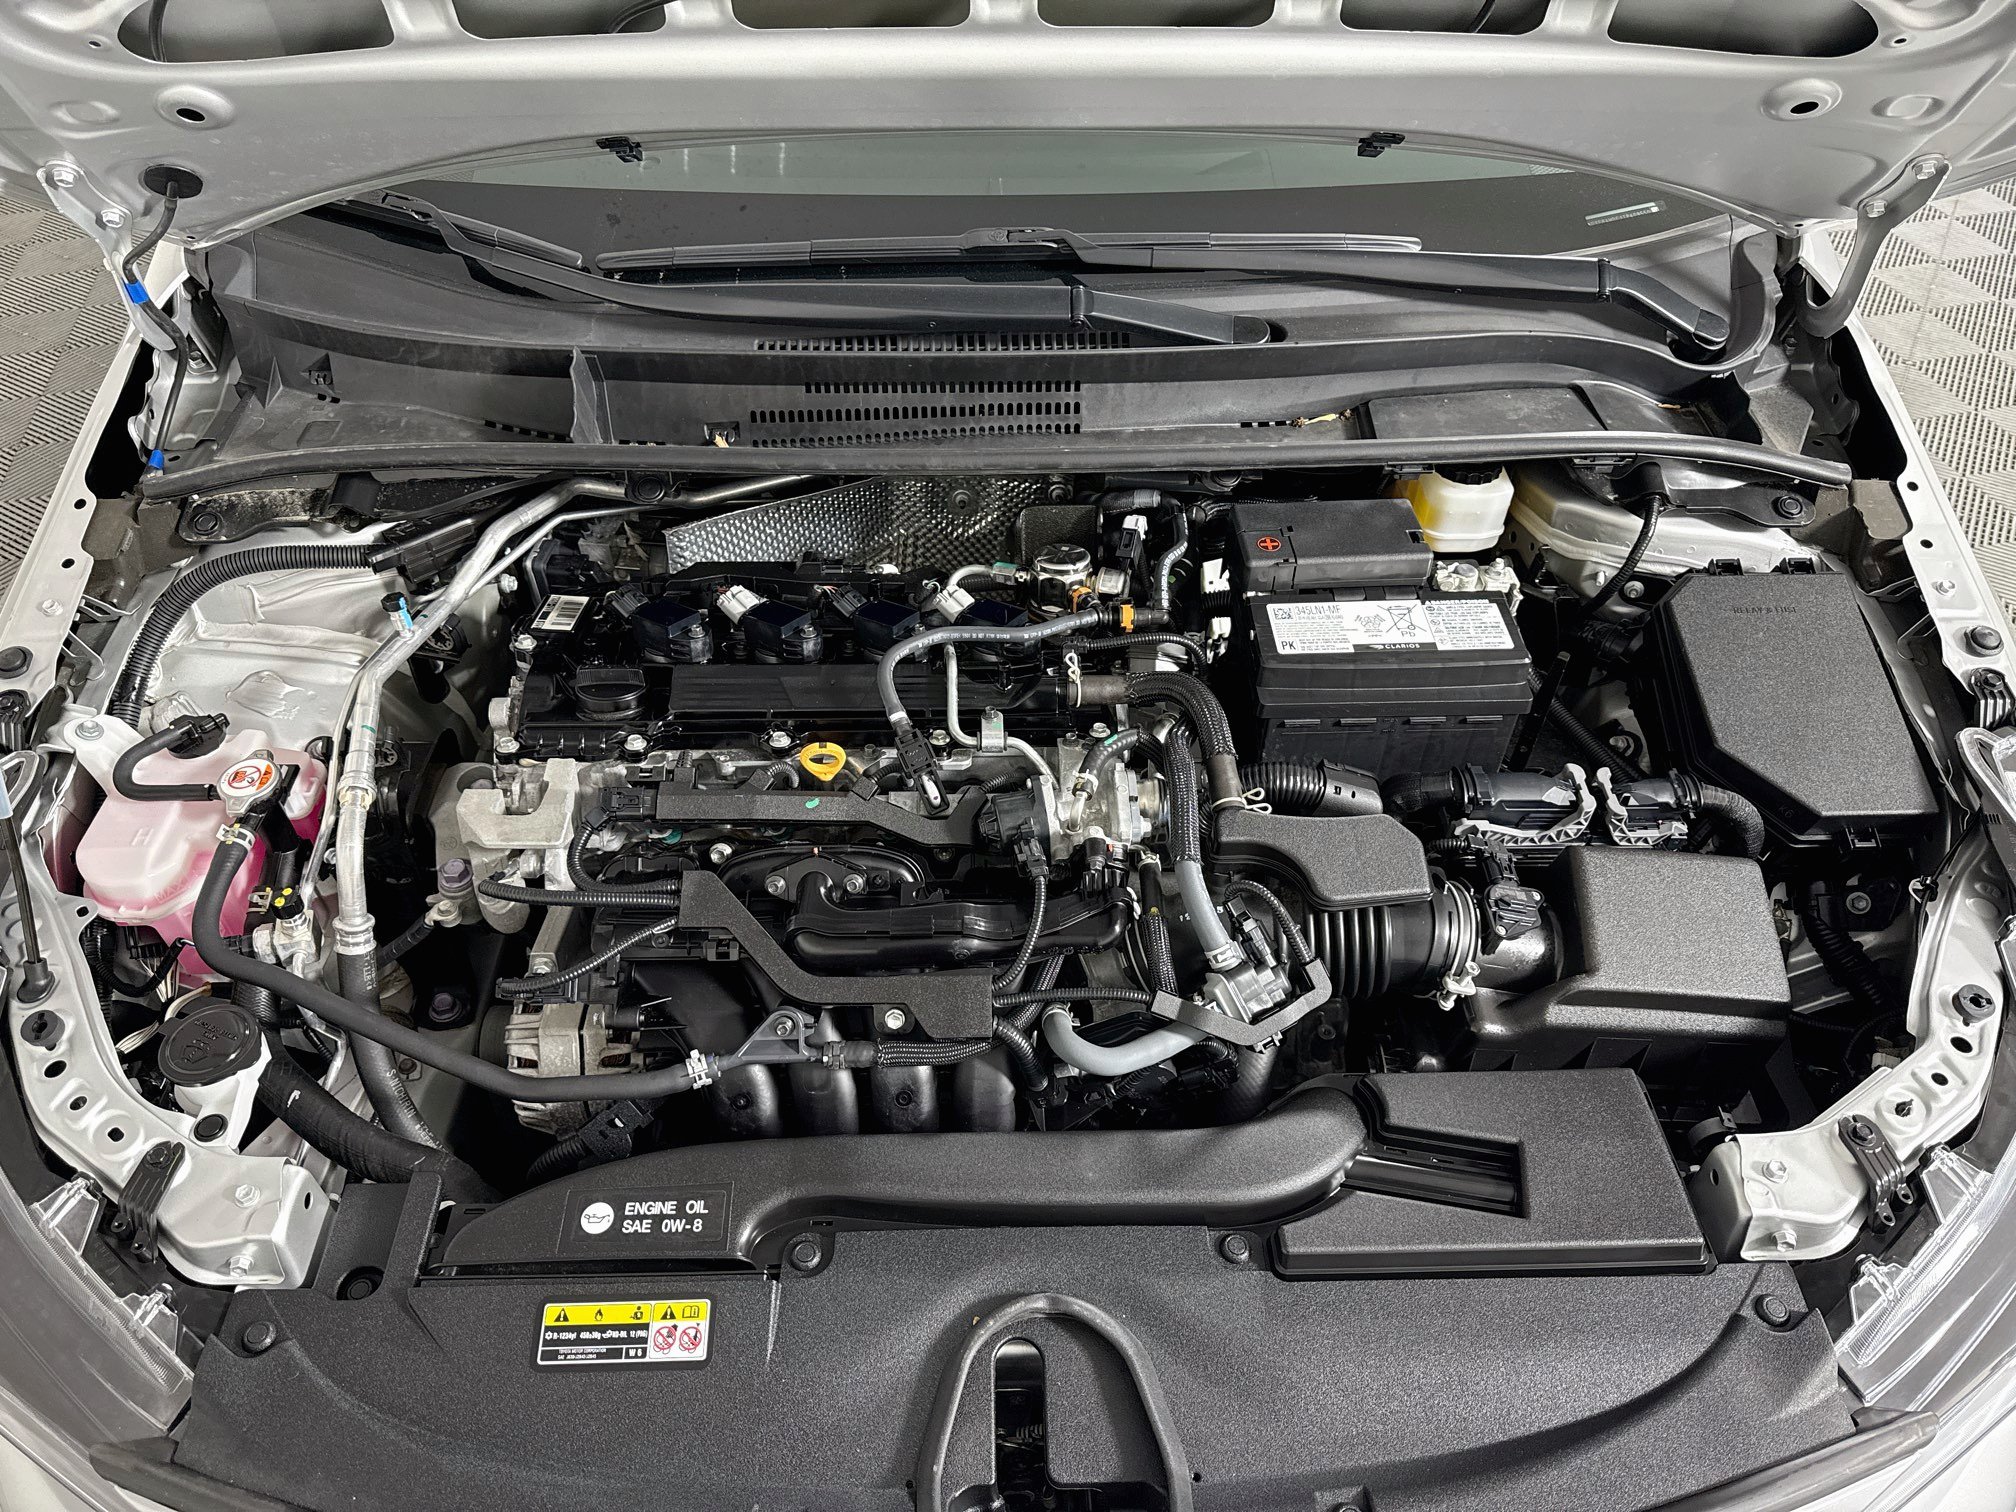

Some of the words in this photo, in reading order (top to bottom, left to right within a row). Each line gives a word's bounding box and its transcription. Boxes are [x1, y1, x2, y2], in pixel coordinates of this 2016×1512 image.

[1295, 604, 1341, 616] 345LN1-MF
[1281, 641, 1296, 650] PK
[624, 1201, 678, 1215] ENGINE
[685, 1200, 709, 1214] OIL
[622, 1219, 653, 1234] SAE
[661, 1218, 703, 1233] 0W-8
[629, 1349, 638, 1357] W
[638, 1348, 643, 1357] 6
